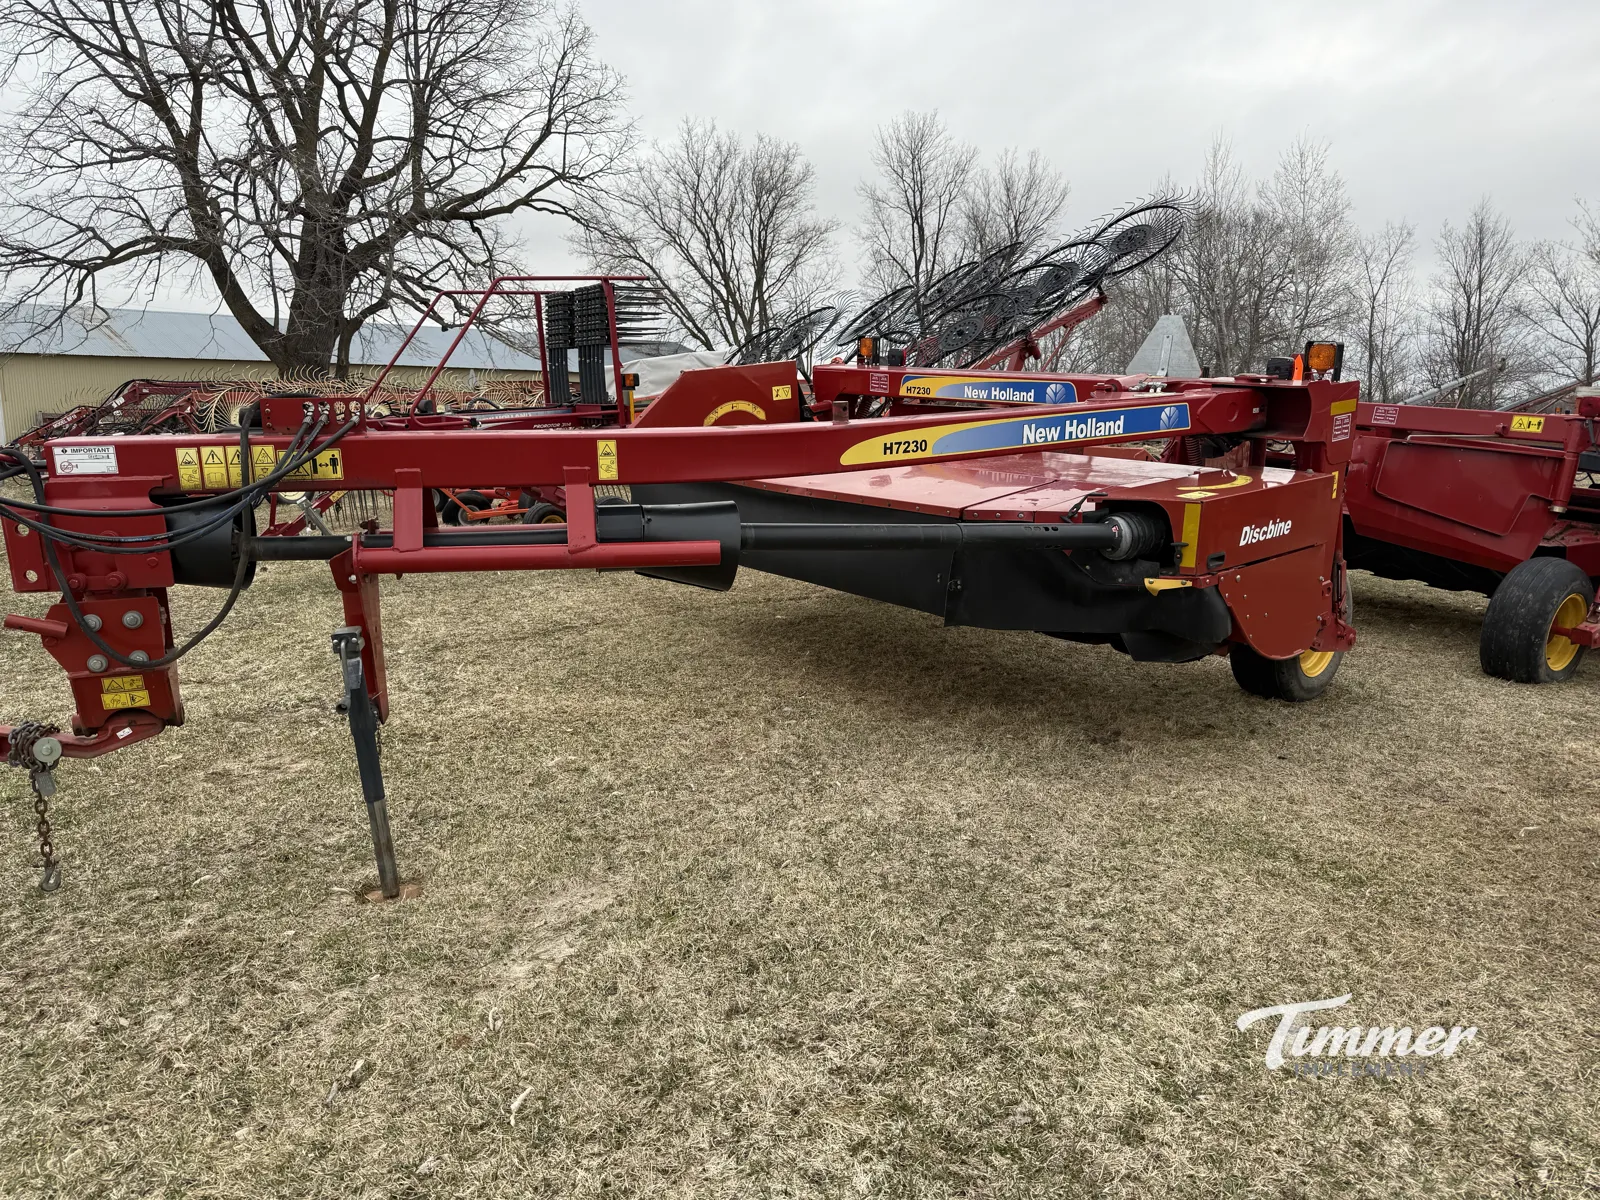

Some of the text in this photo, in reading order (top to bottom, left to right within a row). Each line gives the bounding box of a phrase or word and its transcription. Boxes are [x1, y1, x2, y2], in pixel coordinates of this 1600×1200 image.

[906, 385, 1035, 402] H7230 New Holland
[883, 415, 1125, 455] H7230 New Holland
[1239, 518, 1292, 546] Discbine
